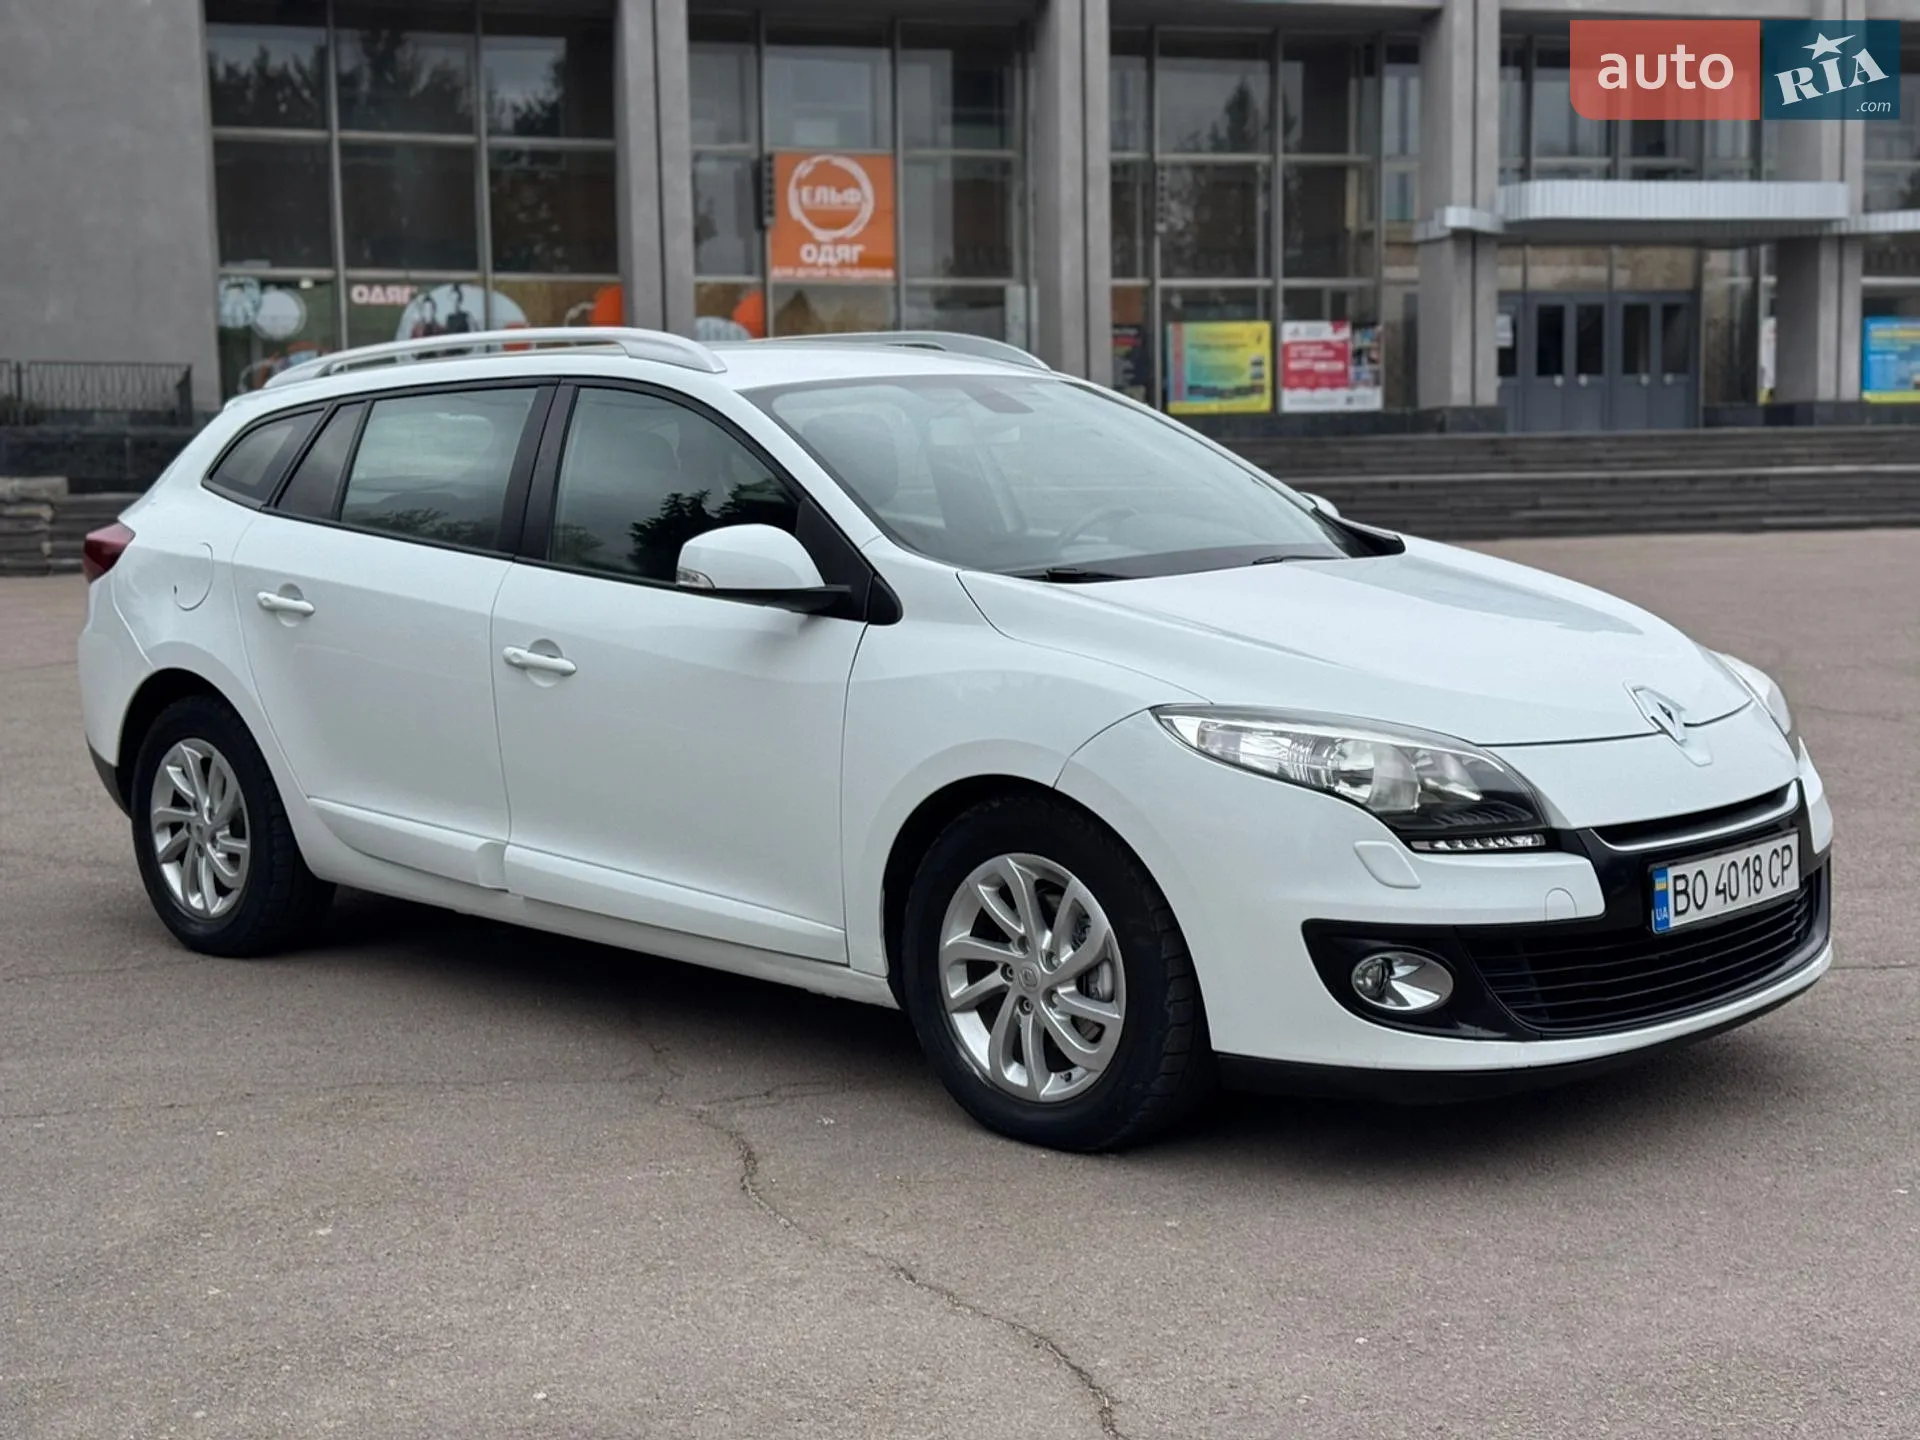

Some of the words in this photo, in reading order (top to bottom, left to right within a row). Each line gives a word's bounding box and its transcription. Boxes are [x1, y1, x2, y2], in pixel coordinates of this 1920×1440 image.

[800, 185, 863, 205] ЕЛЬФ
[799, 243, 867, 267] ОДЯГ
[351, 284, 418, 305] ОДЯГ
[1672, 869, 1708, 917] BO
[1715, 854, 1763, 905] 4018
[1769, 844, 1793, 888] CP
[1655, 907, 1669, 921] UA
